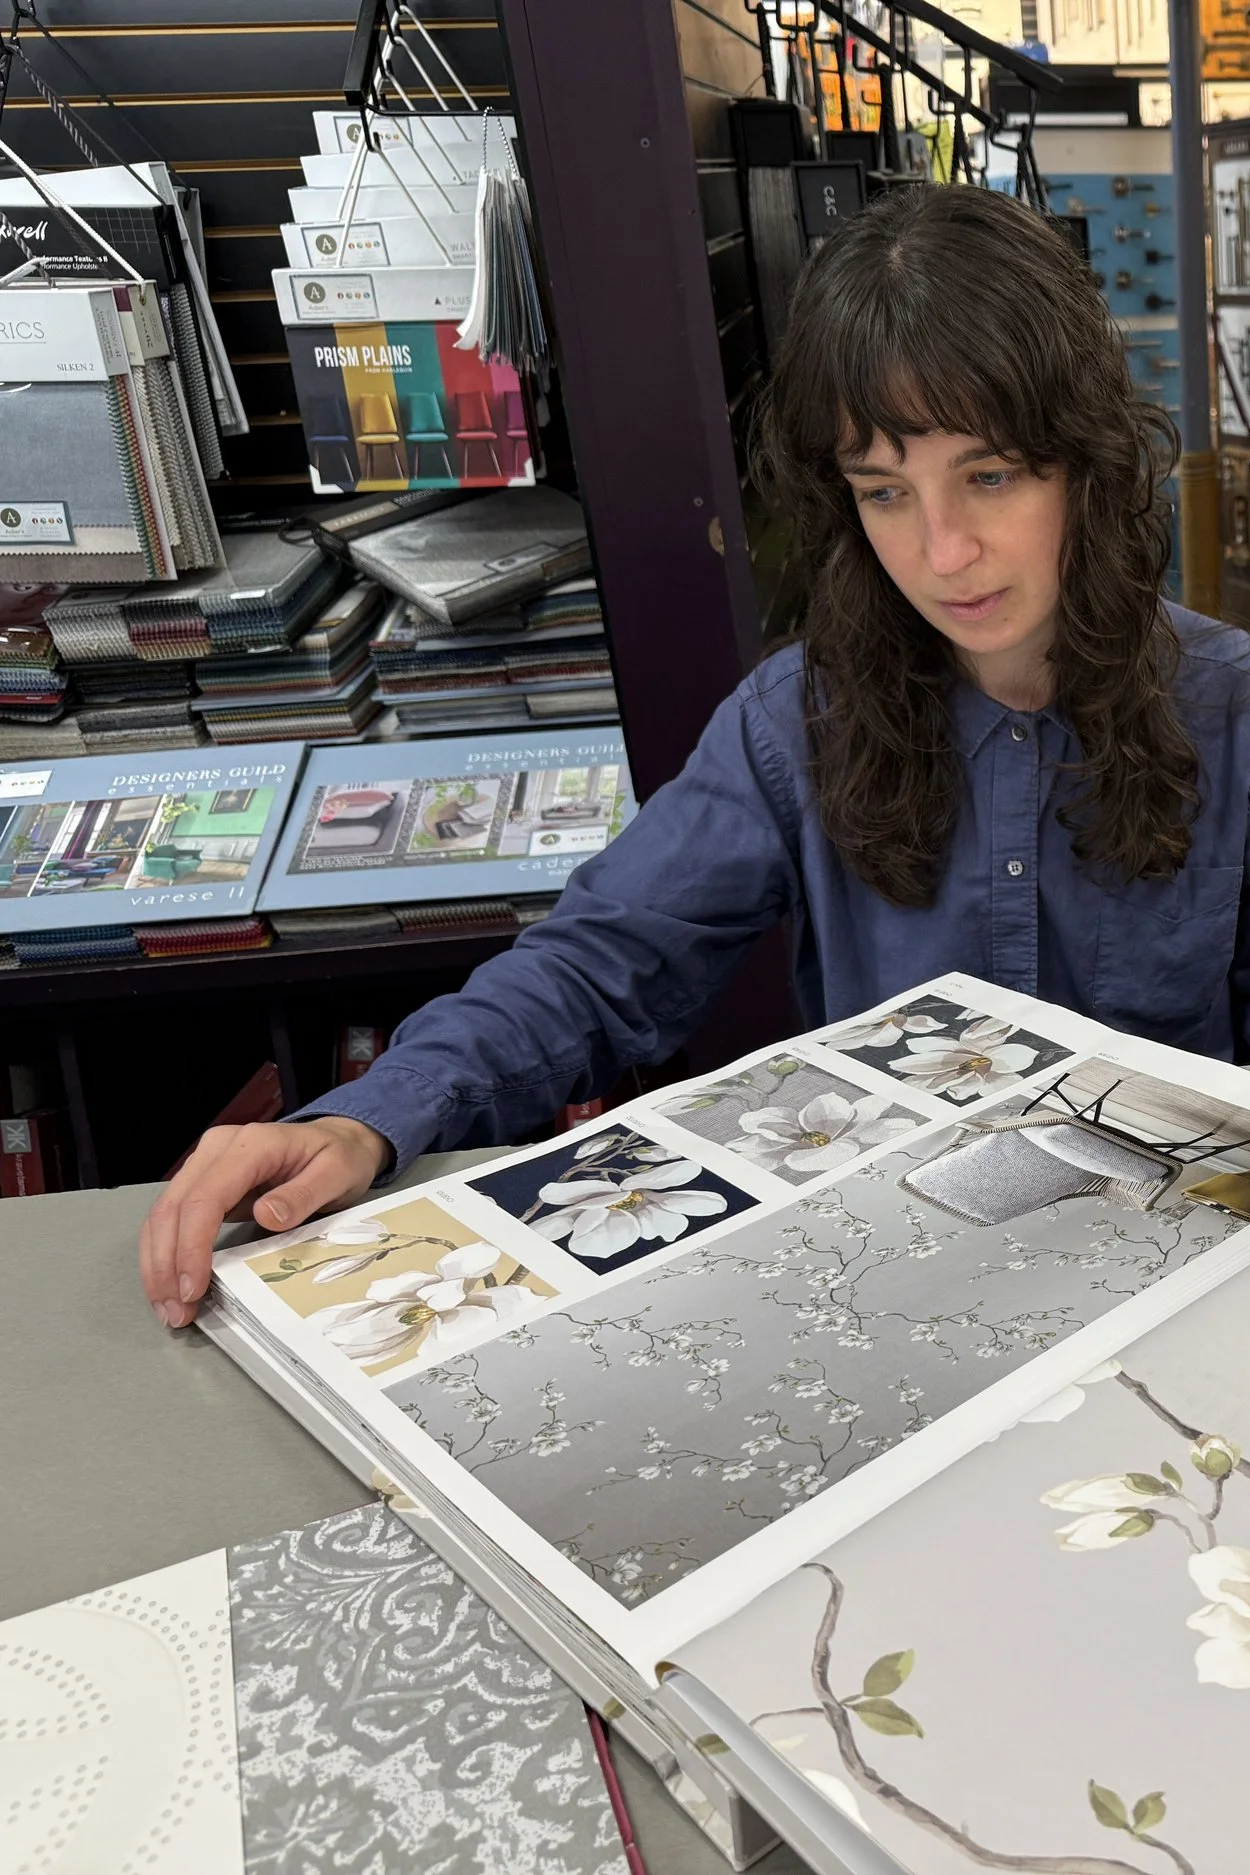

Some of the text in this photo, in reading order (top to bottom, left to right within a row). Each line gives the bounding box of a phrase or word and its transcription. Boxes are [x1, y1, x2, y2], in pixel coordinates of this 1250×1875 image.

[314, 343, 413, 368] PRISM PLAINS
[56, 362, 95, 372] SILKEN 2
[468, 746, 570, 763] DESIGNERS
[112, 763, 287, 788] DESIGNERS GUILD
[108, 776, 283, 796] essentials
[131, 890, 214, 907] varese
